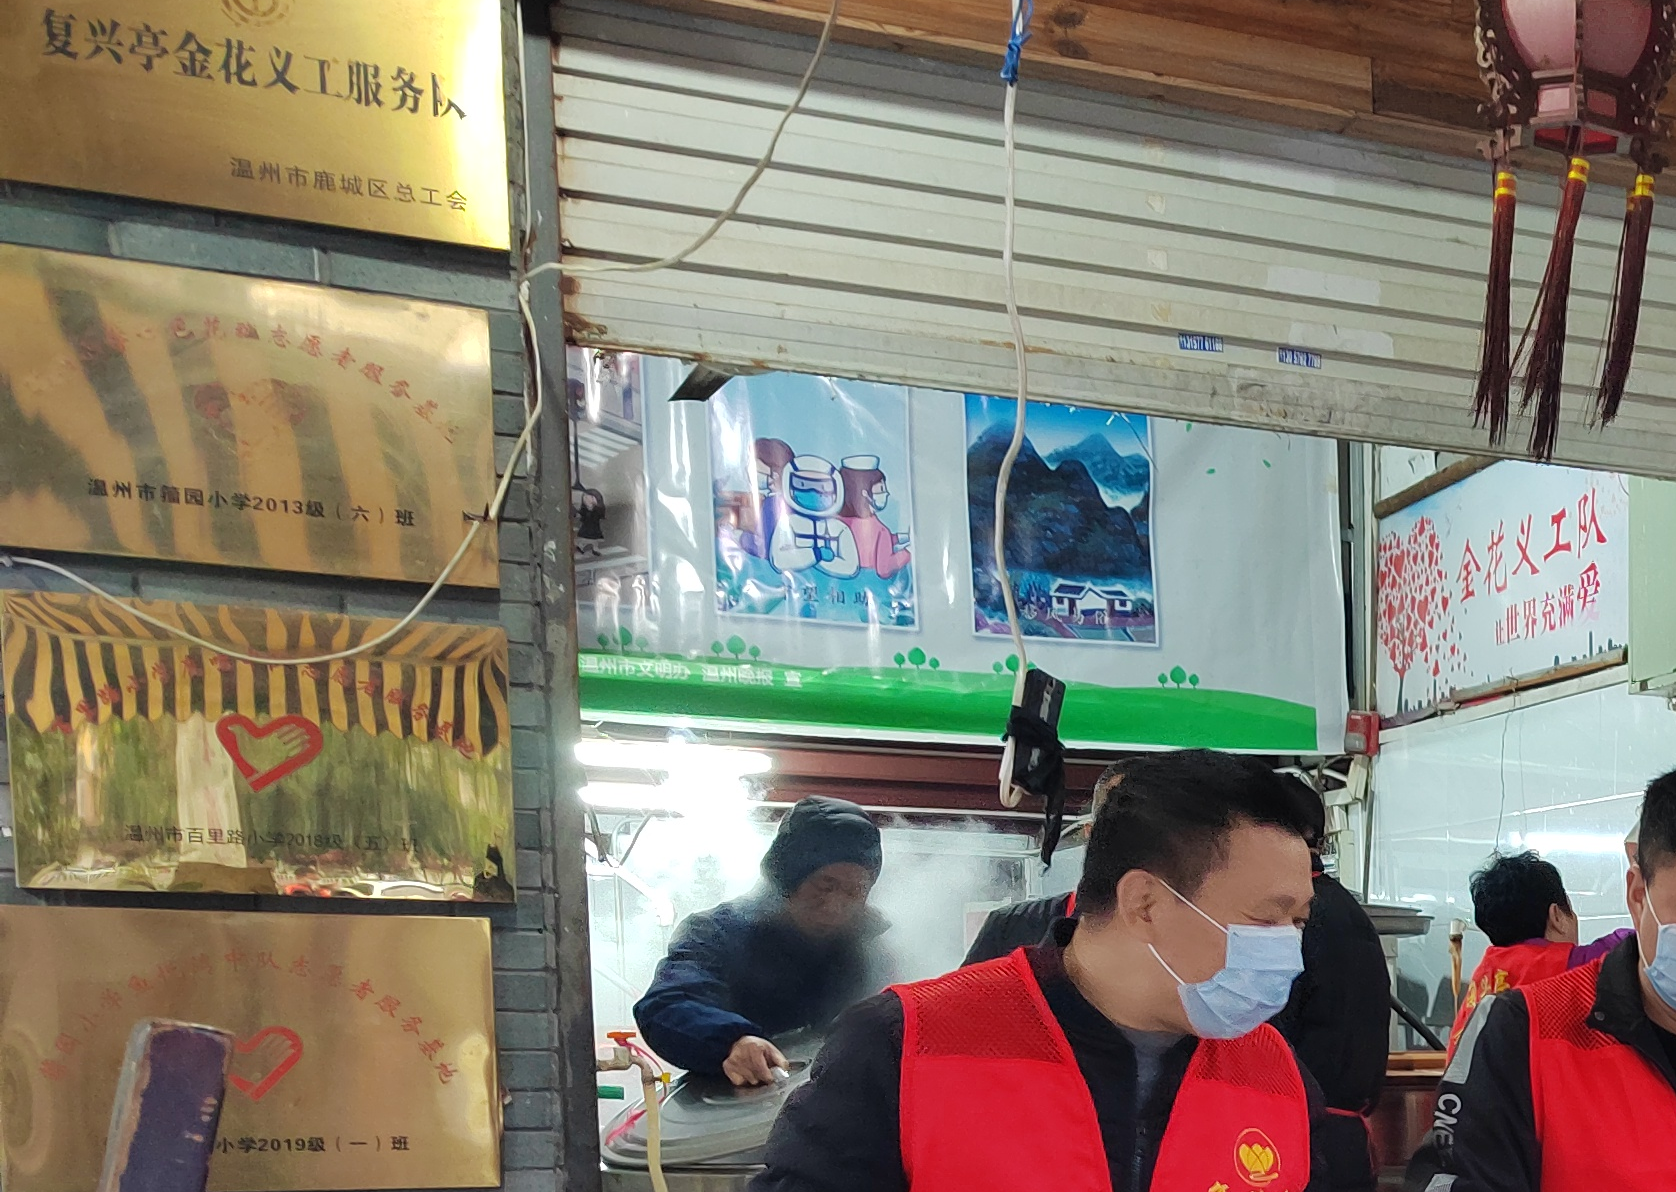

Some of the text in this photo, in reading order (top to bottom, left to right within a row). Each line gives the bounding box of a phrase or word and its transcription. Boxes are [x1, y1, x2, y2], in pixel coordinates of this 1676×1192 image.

[40, 7, 468, 120] 复兴亭金花义工服务队
[229, 157, 468, 212] 温州市鹿城区总工会
[1456, 488, 1607, 604] 金花义工队
